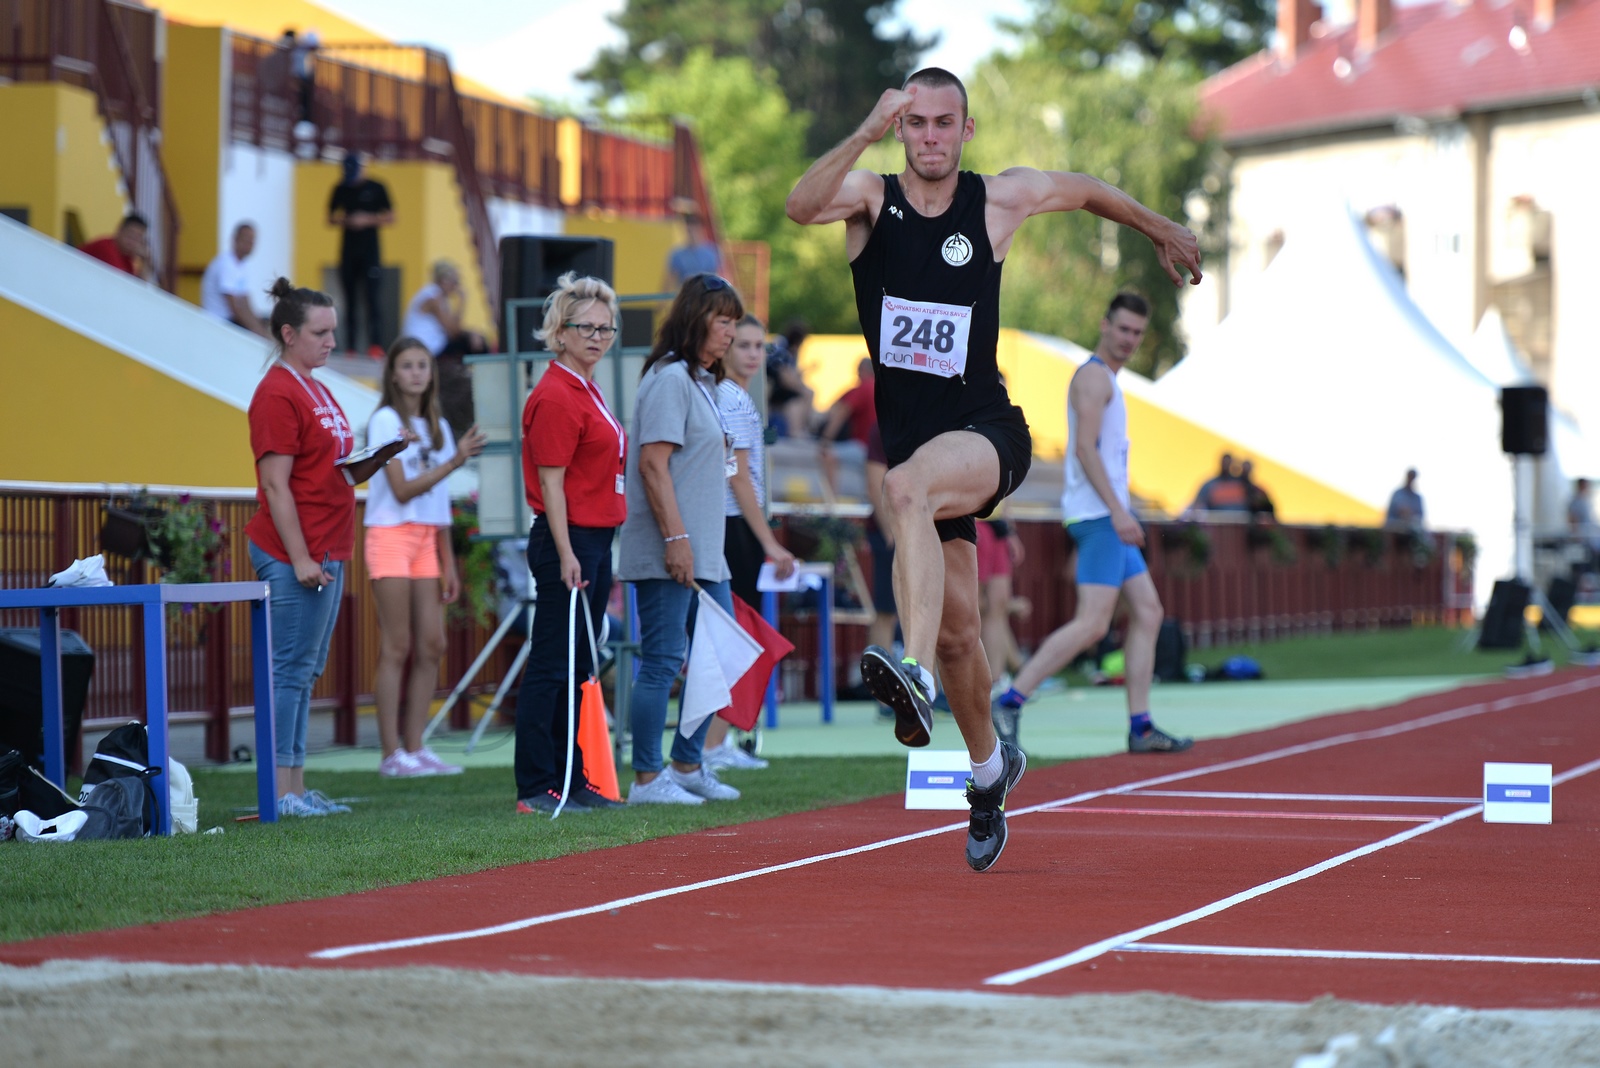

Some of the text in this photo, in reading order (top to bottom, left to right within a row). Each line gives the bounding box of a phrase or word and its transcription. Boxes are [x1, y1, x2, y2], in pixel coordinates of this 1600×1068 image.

[894, 304, 968, 318] HRVATSKI ATLETSKI SAVEZ
[891, 315, 956, 354] 248
[885, 352, 958, 373] run trek
